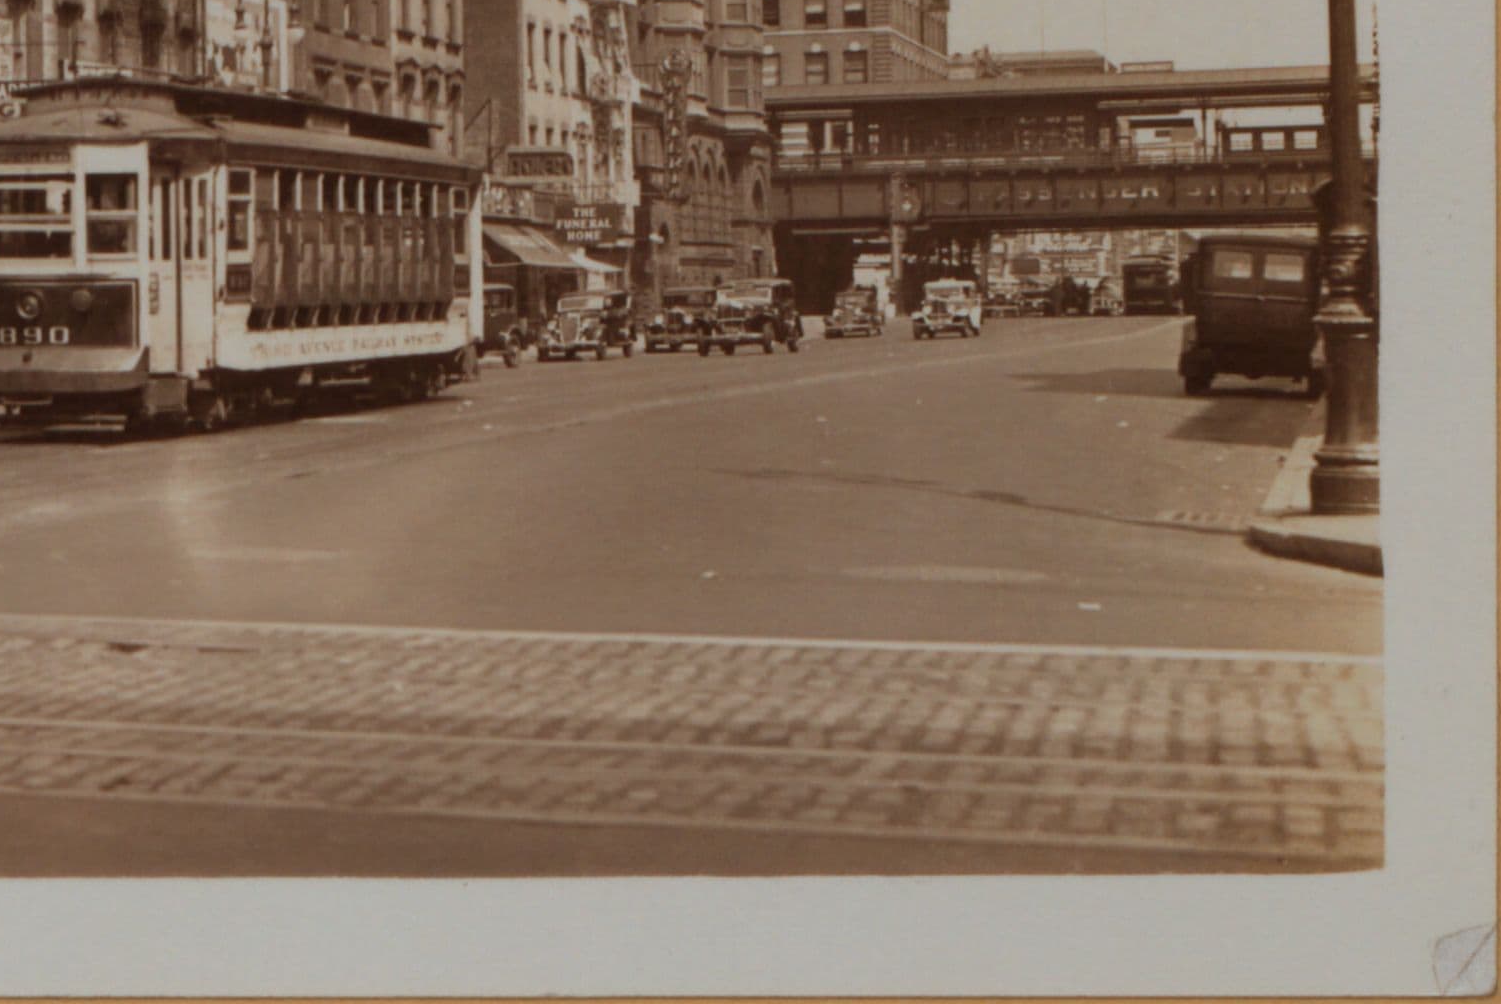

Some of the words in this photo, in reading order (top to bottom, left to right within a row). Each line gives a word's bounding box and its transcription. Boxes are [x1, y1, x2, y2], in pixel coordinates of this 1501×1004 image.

[571, 207, 596, 218] THE
[556, 219, 612, 230] FUNERAL
[566, 231, 600, 242] HOME
